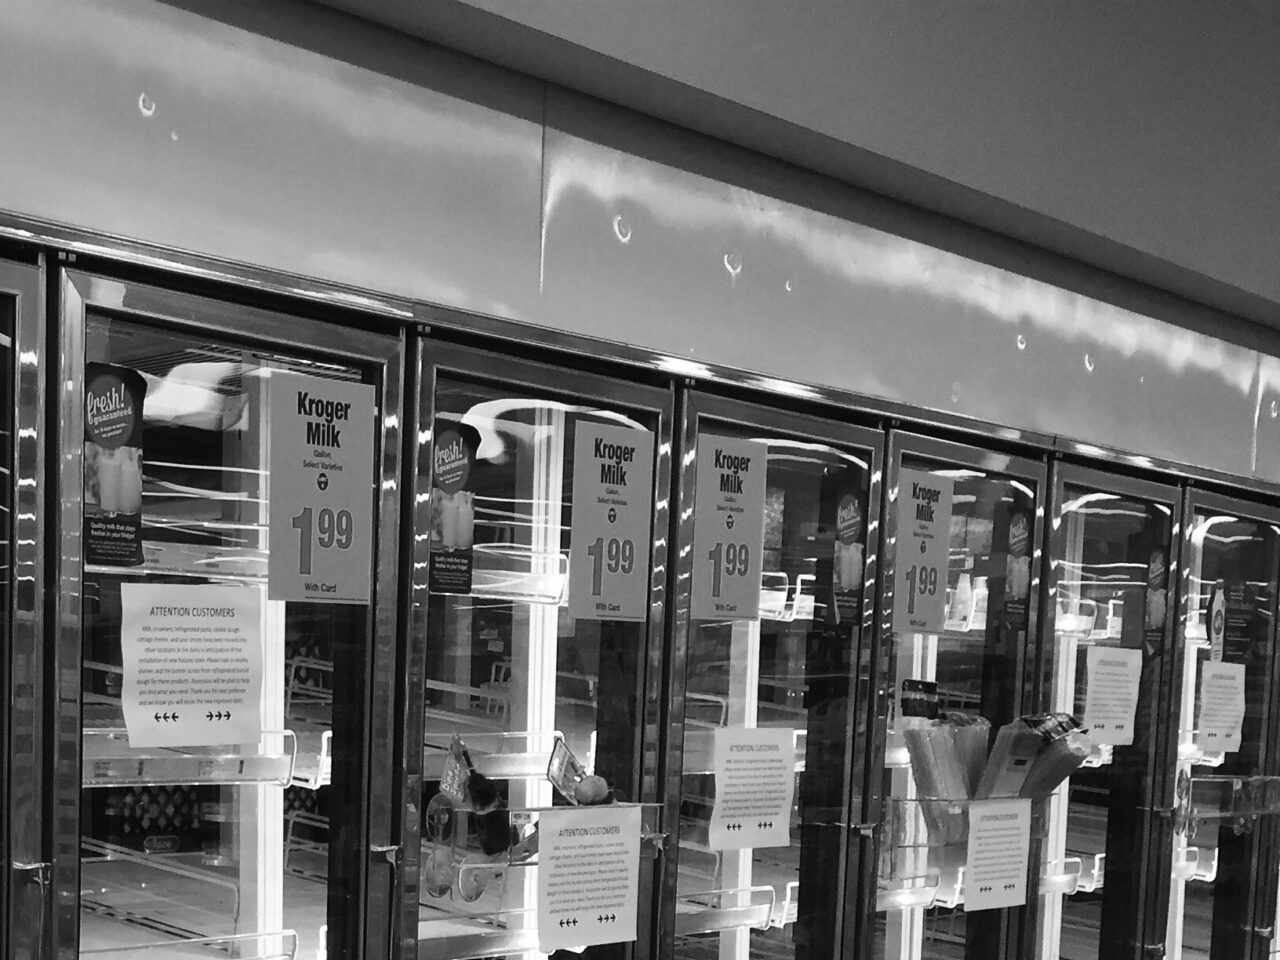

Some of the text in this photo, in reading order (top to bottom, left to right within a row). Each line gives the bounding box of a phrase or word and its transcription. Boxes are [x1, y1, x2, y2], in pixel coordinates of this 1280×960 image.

[87, 383, 125, 425] fresh!
[94, 406, 132, 425] guaranteed
[297, 391, 351, 424] Kroger
[306, 421, 341, 448] Milk
[594, 437, 636, 466] Kroger
[714, 448, 751, 475] Kroger
[600, 463, 627, 487] Milk
[720, 473, 743, 495] Milk
[912, 481, 941, 506] Kroger
[915, 503, 935, 523] Milk
[304, 582, 337, 592] With Card
[150, 606, 234, 617] ATTENTION CUSTOMERS
[558, 826, 621, 837] ATTENTION CUSTOMERS
